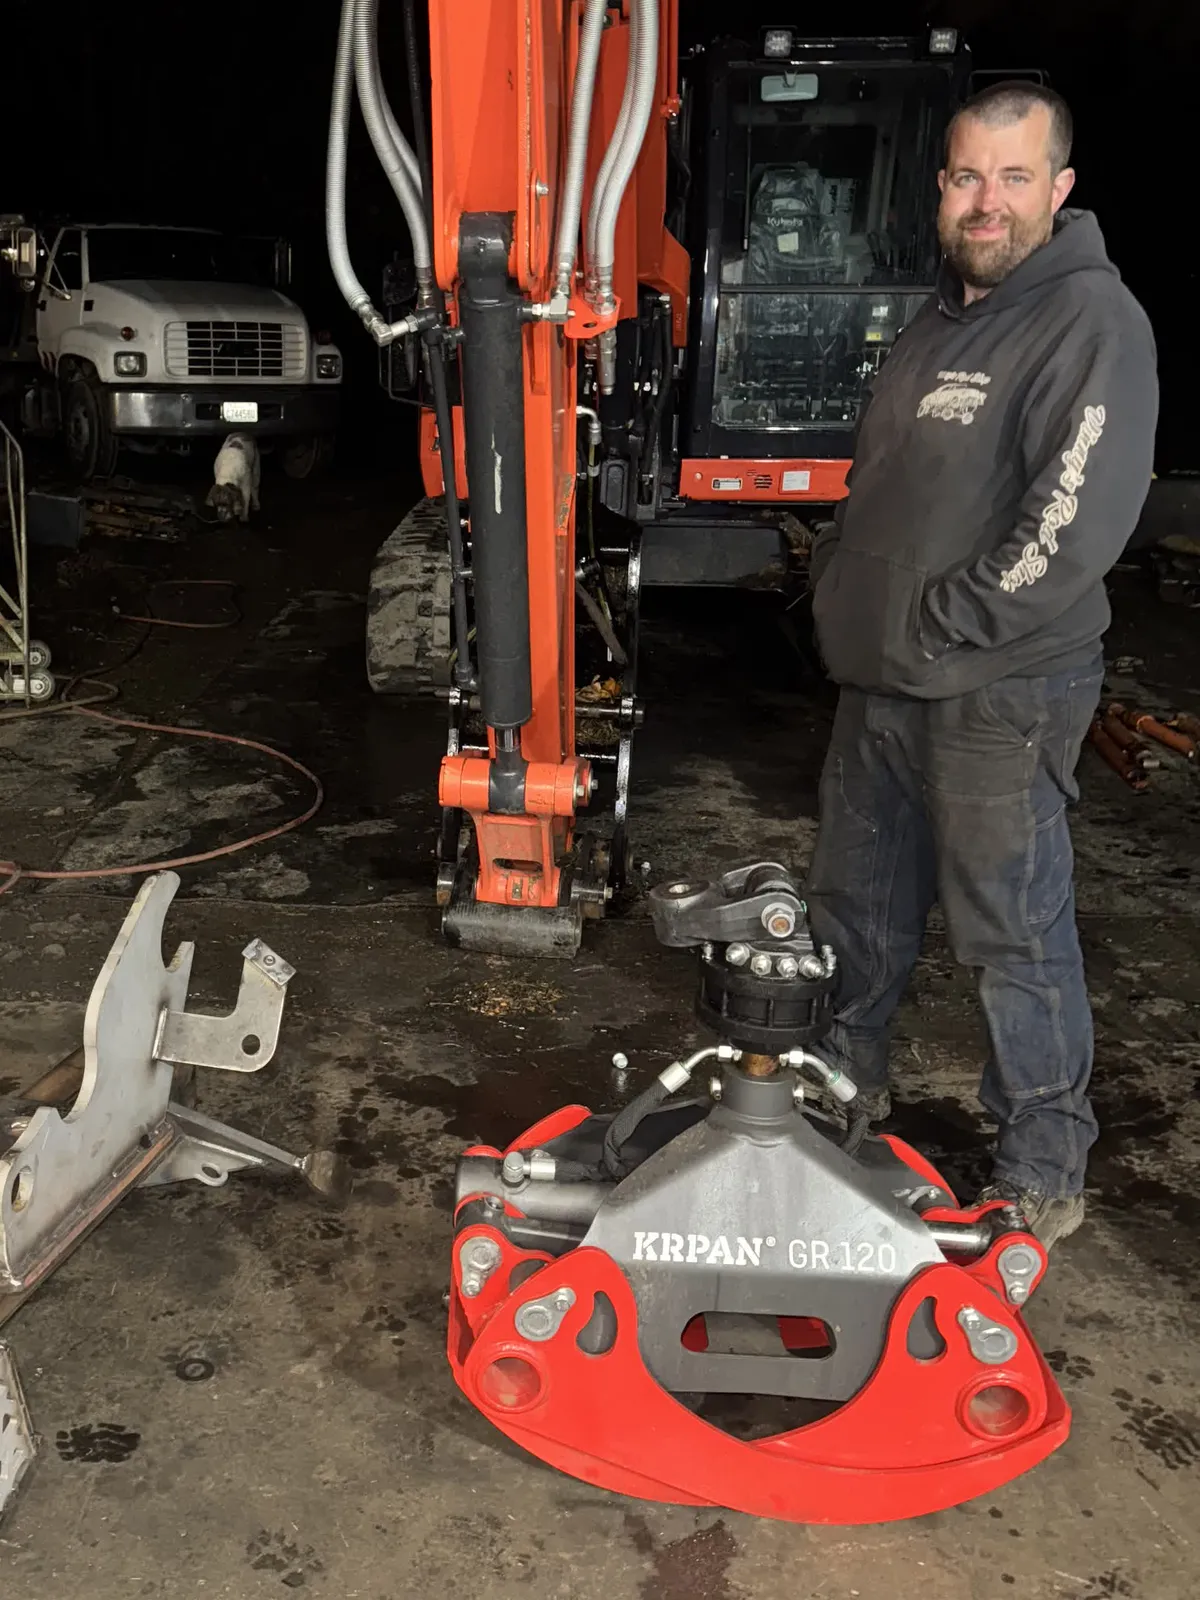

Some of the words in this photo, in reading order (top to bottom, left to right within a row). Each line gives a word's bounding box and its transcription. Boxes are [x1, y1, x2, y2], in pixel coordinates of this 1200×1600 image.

[1039, 489, 1078, 555] Rod
[1000, 542, 1048, 593] Shop
[788, 1239, 830, 1270] GR
[841, 1241, 896, 1273] 120
